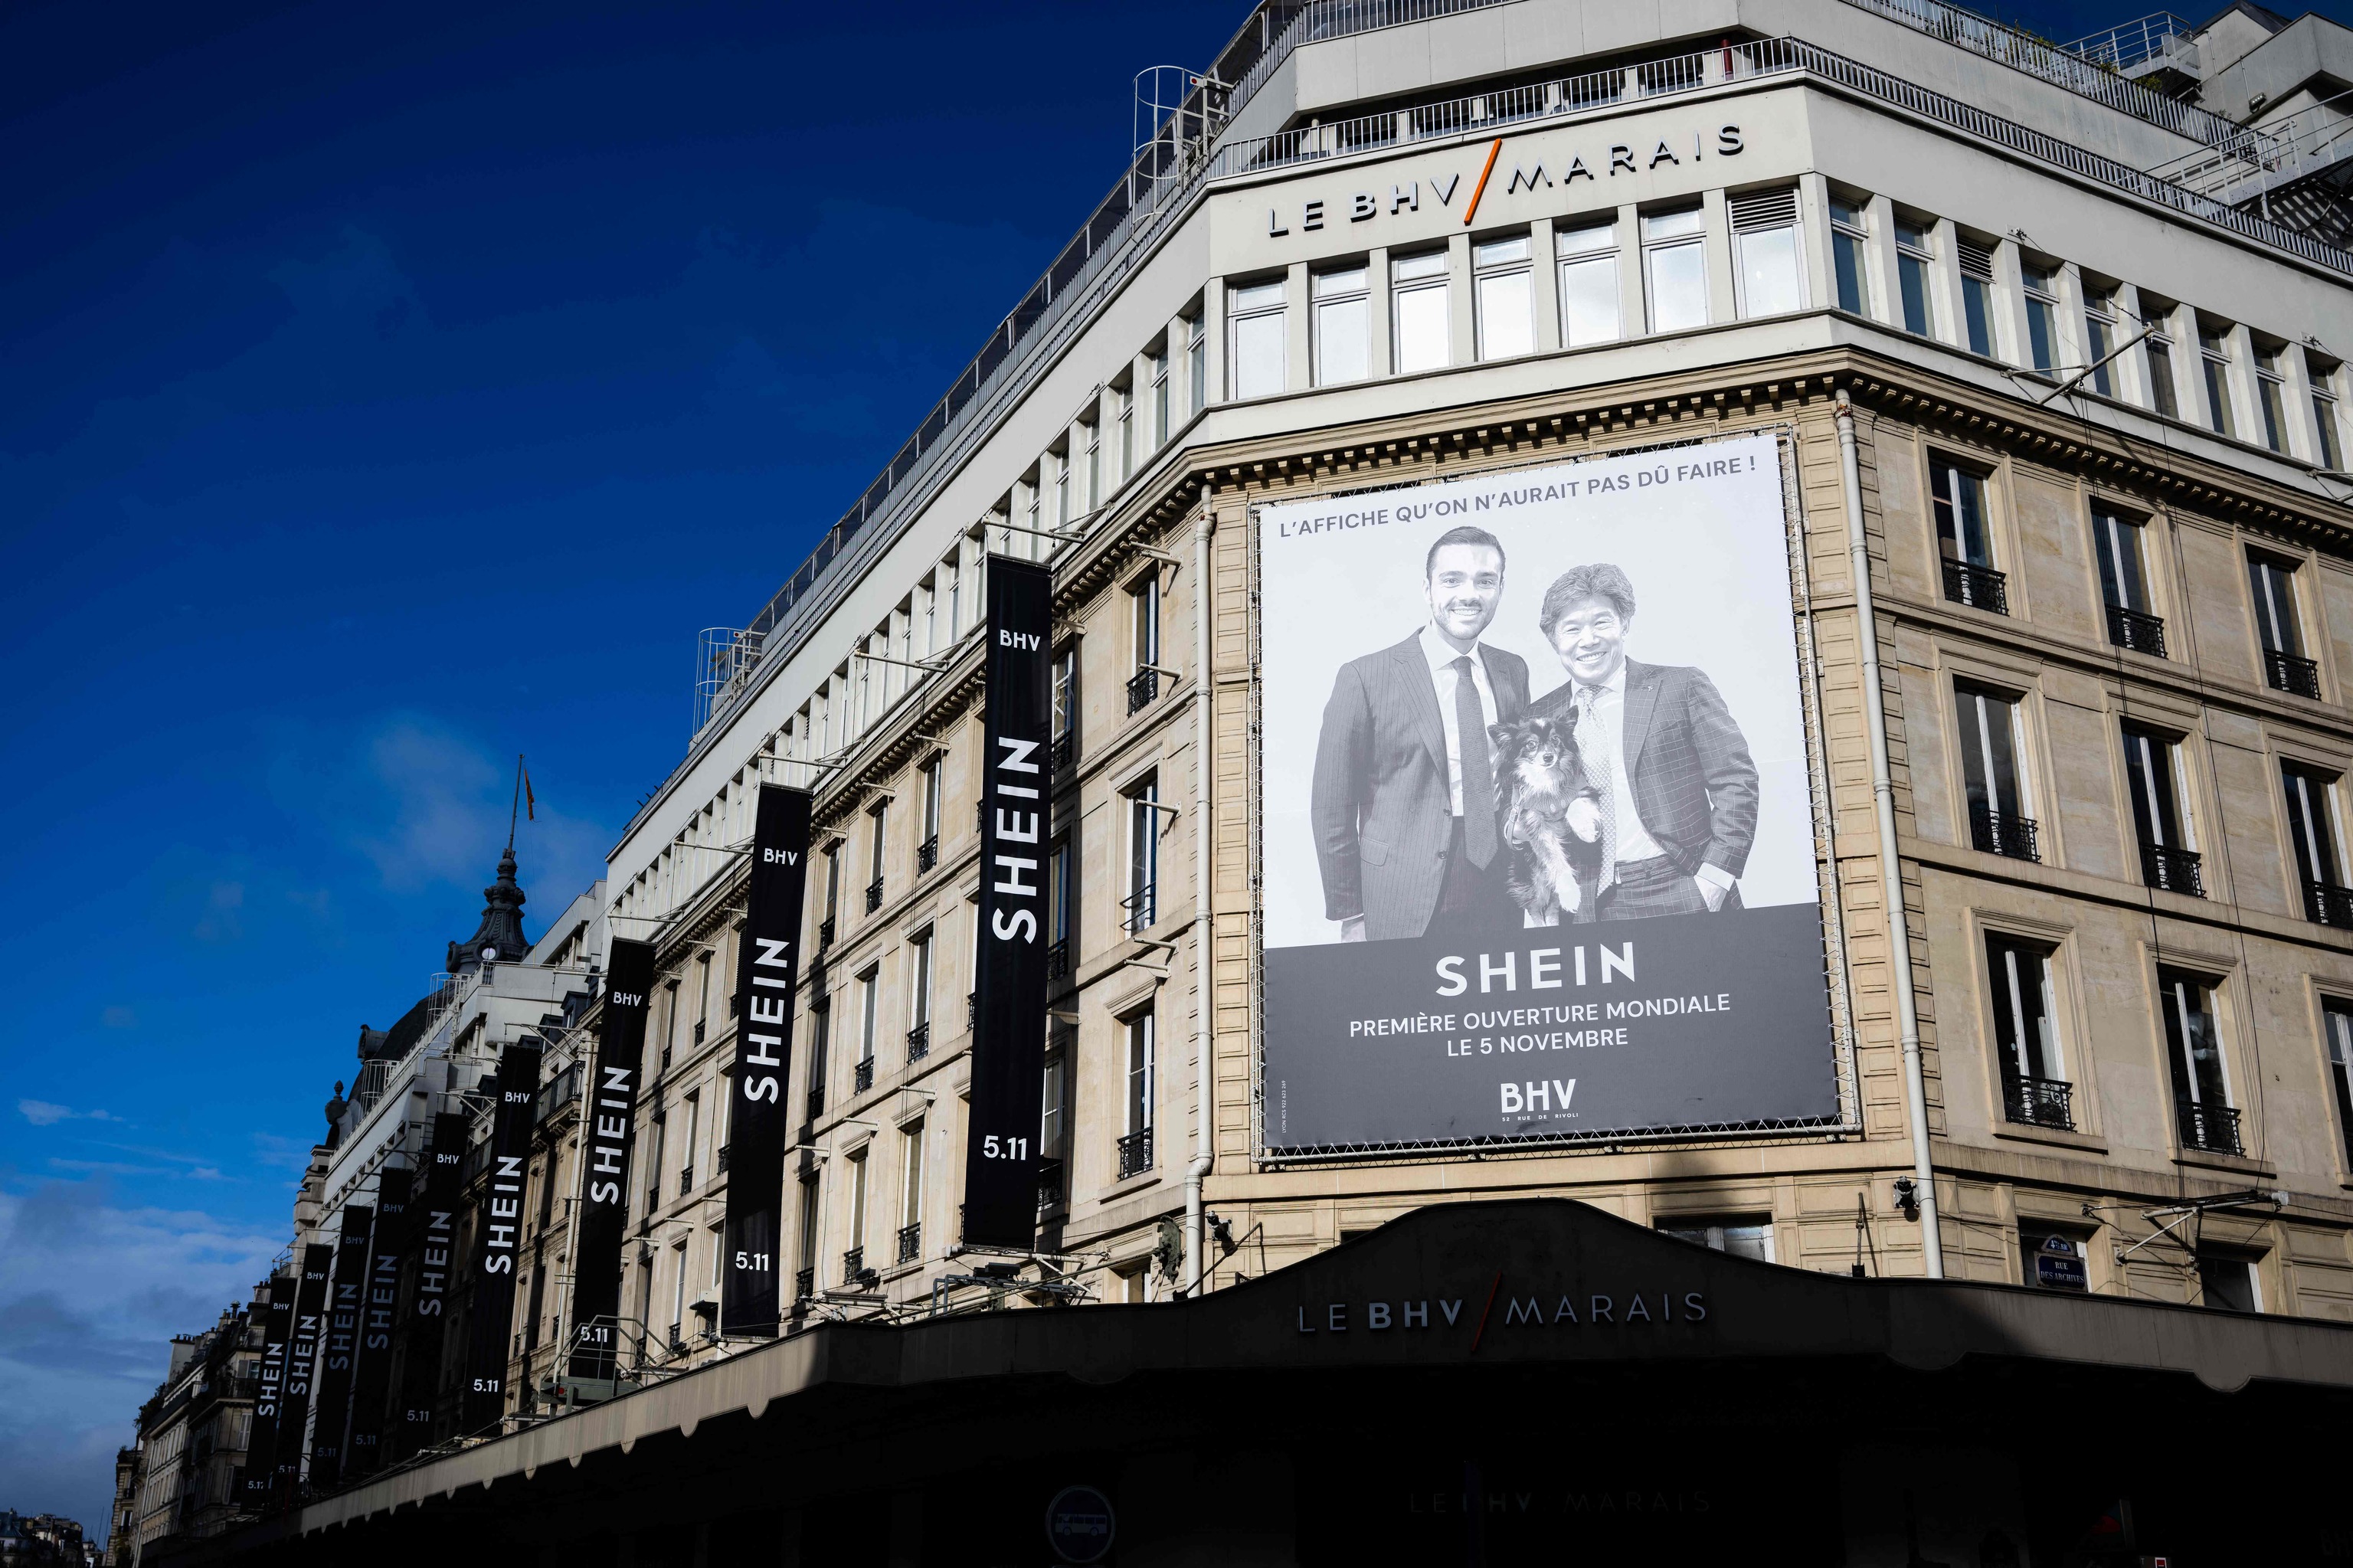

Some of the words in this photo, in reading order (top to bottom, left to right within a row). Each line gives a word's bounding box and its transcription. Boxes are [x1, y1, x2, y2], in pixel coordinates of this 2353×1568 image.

[1268, 199, 1324, 237] LE
[1588, 473, 1630, 496] PAS
[1638, 464, 1670, 487] DÛ
[1677, 457, 1742, 482] FAIRE
[1000, 629, 1041, 652] BHV
[992, 735, 1041, 944] SHEIN
[763, 847, 798, 866] BHV
[1435, 941, 1636, 997] SHEIN
[613, 991, 643, 1007] BHV
[744, 937, 790, 1105] SHEIN
[1350, 1011, 1457, 1037] PREMIÈRE
[1463, 1003, 1599, 1030] OUVERTURE
[1606, 993, 1730, 1020] MONDIALE
[1447, 1039, 1472, 1057] LE
[1480, 1037, 1493, 1055] 5
[1500, 1027, 1628, 1053] NOVEMBRE
[504, 1091, 531, 1104] BHV
[1500, 1079, 1576, 1114] BHV
[590, 1066, 633, 1206] SHEIN
[983, 1134, 1028, 1161] 5.11
[437, 1153, 460, 1165] BHV
[383, 1203, 404, 1213] BHV
[484, 1155, 524, 1275] SHEIN
[345, 1235, 365, 1246] BHV
[417, 1210, 453, 1318] SHEIN
[735, 1251, 770, 1272] 5.11
[2054, 1262, 2068, 1270] RUE
[306, 1271, 325, 1282] BHV
[2040, 1271, 2054, 1279] DES
[2054, 1273, 2084, 1283] ARCHIVES
[273, 1301, 290, 1311] BHV
[366, 1254, 399, 1351] SHEIN
[329, 1282, 360, 1371] SHEIN
[1299, 1304, 1347, 1332] LE
[580, 1325, 609, 1343] 5.11
[289, 1314, 318, 1396] SHEIN
[257, 1341, 283, 1417] SHEIN
[473, 1378, 499, 1393] 5.11
[407, 1409, 430, 1422] 5.11
[317, 1446, 336, 1458] 5.11
[355, 1434, 376, 1445] 5.11
